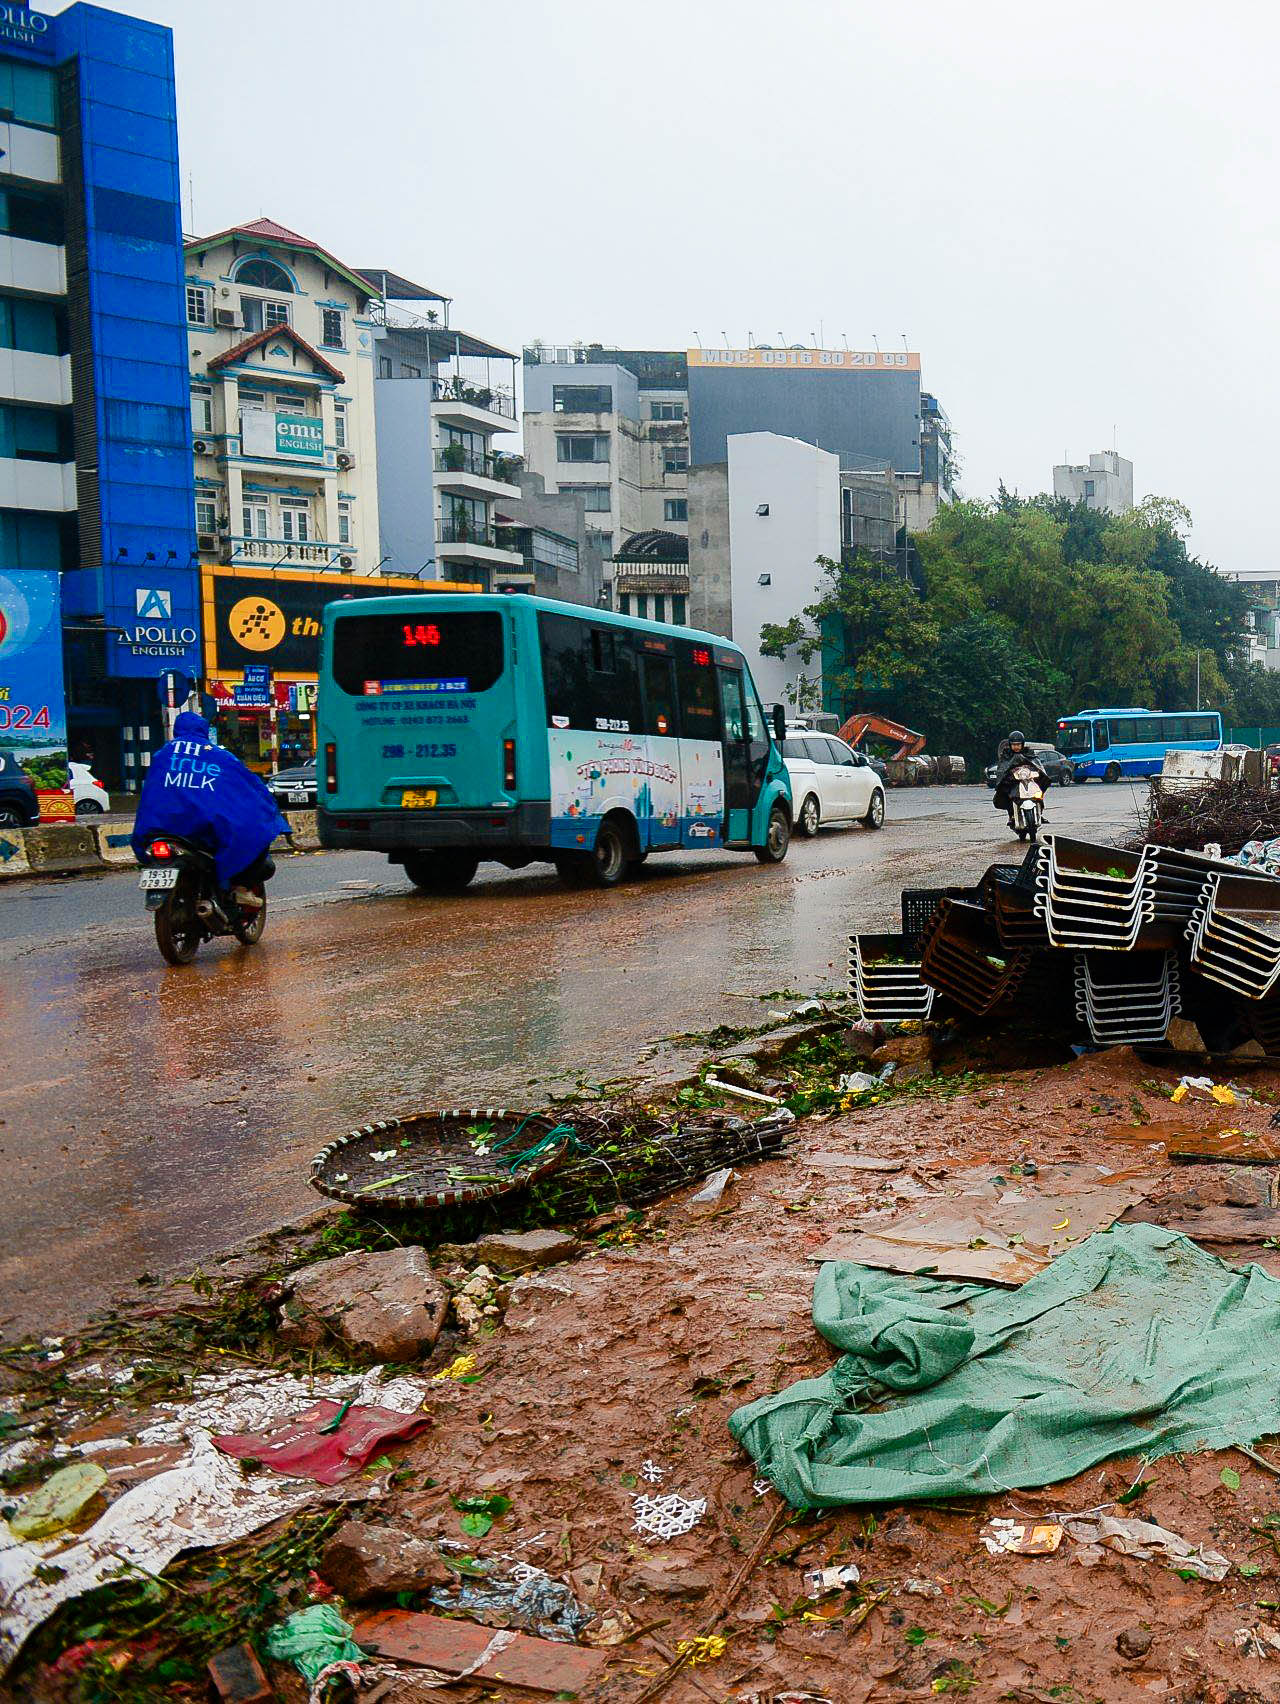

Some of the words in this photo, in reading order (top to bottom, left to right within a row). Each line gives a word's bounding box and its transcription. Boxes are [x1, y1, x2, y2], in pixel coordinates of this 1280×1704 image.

[761, 351, 813, 365] 0916
[819, 352, 845, 366] 80
[851, 352, 876, 367] 20
[882, 352, 908, 367] 99
[279, 438, 322, 451] ENGLISH
[291, 617, 323, 637] th
[132, 646, 185, 656] ENGLISH
[171, 740, 203, 757] TH
[169, 753, 222, 777] true
[164, 772, 217, 792] MILK
